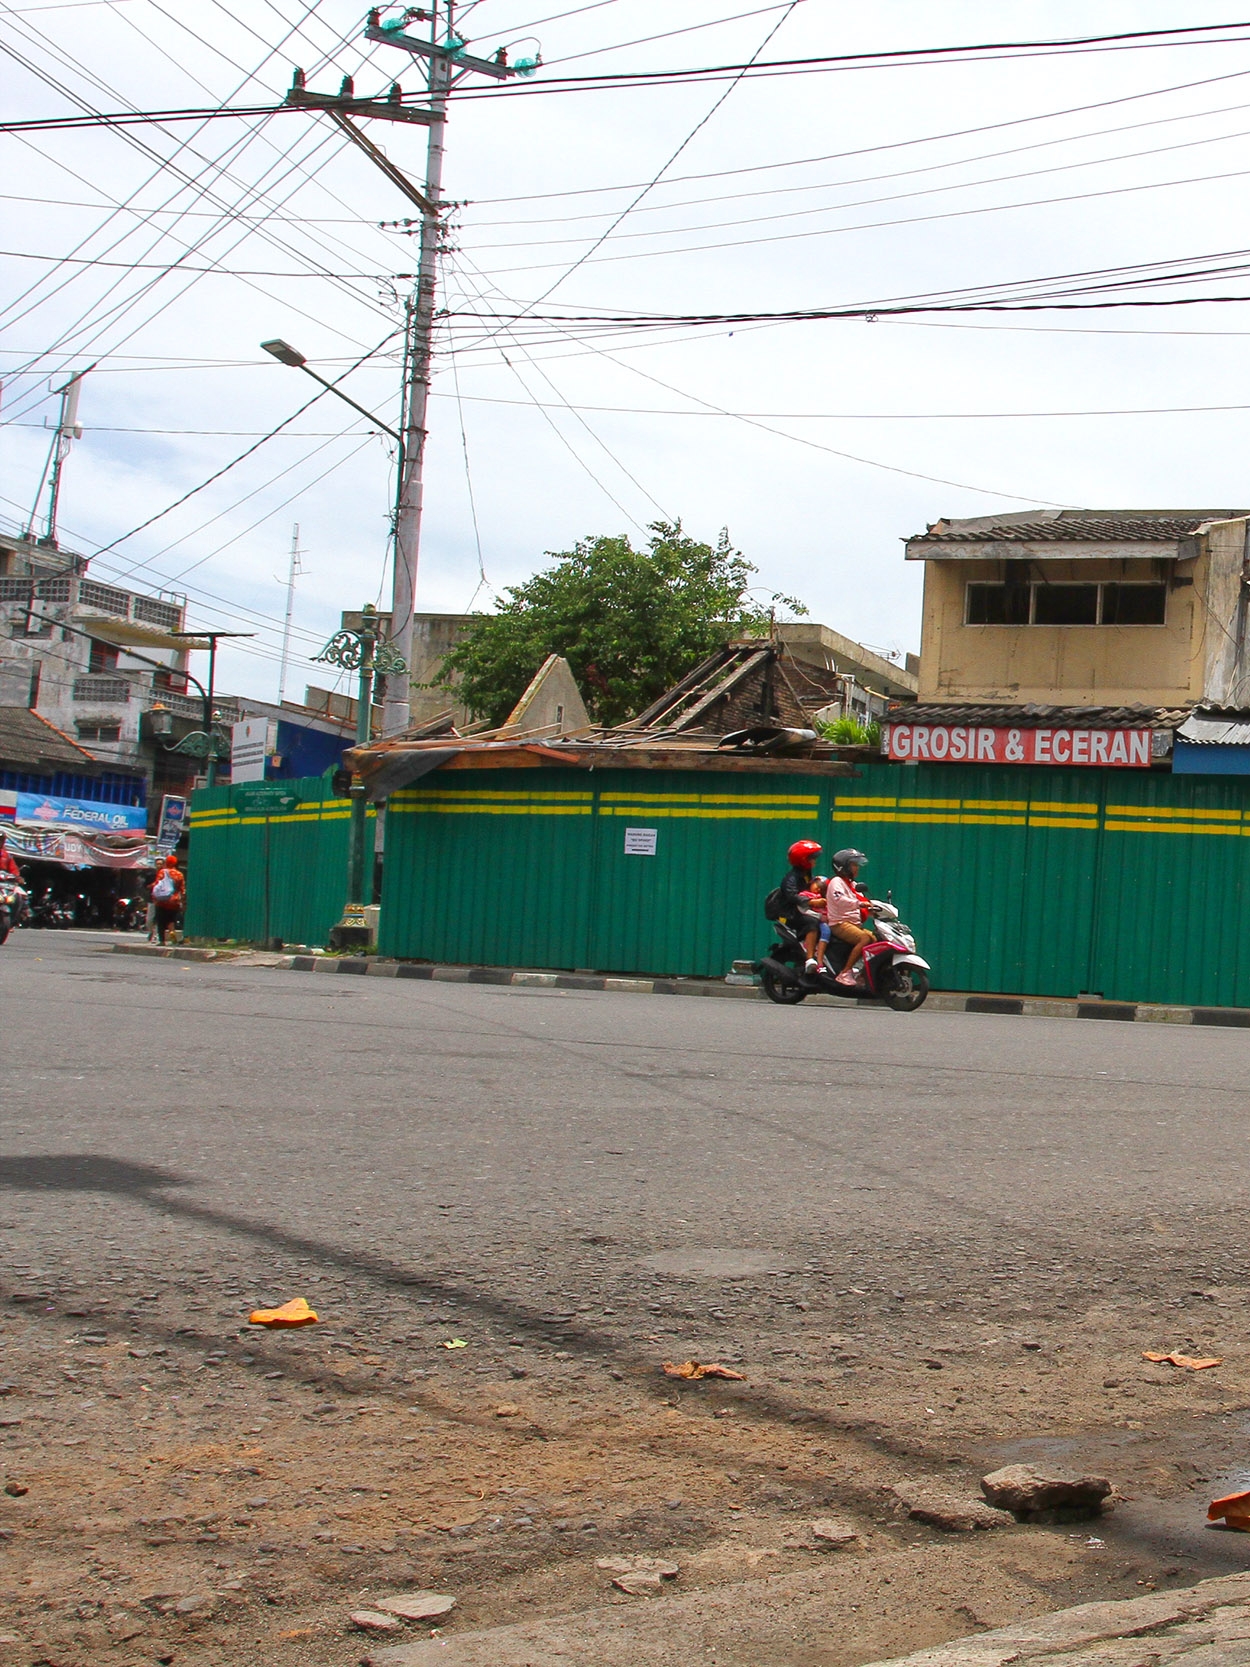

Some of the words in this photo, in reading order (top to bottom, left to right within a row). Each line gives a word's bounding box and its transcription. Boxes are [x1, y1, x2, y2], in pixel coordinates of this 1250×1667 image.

[892, 725, 996, 760] GROSIR
[1004, 728, 1025, 761] &
[1034, 729, 1150, 764] ECERAN
[62, 809, 111, 824] FEDERAL
[112, 814, 129, 826] OIL
